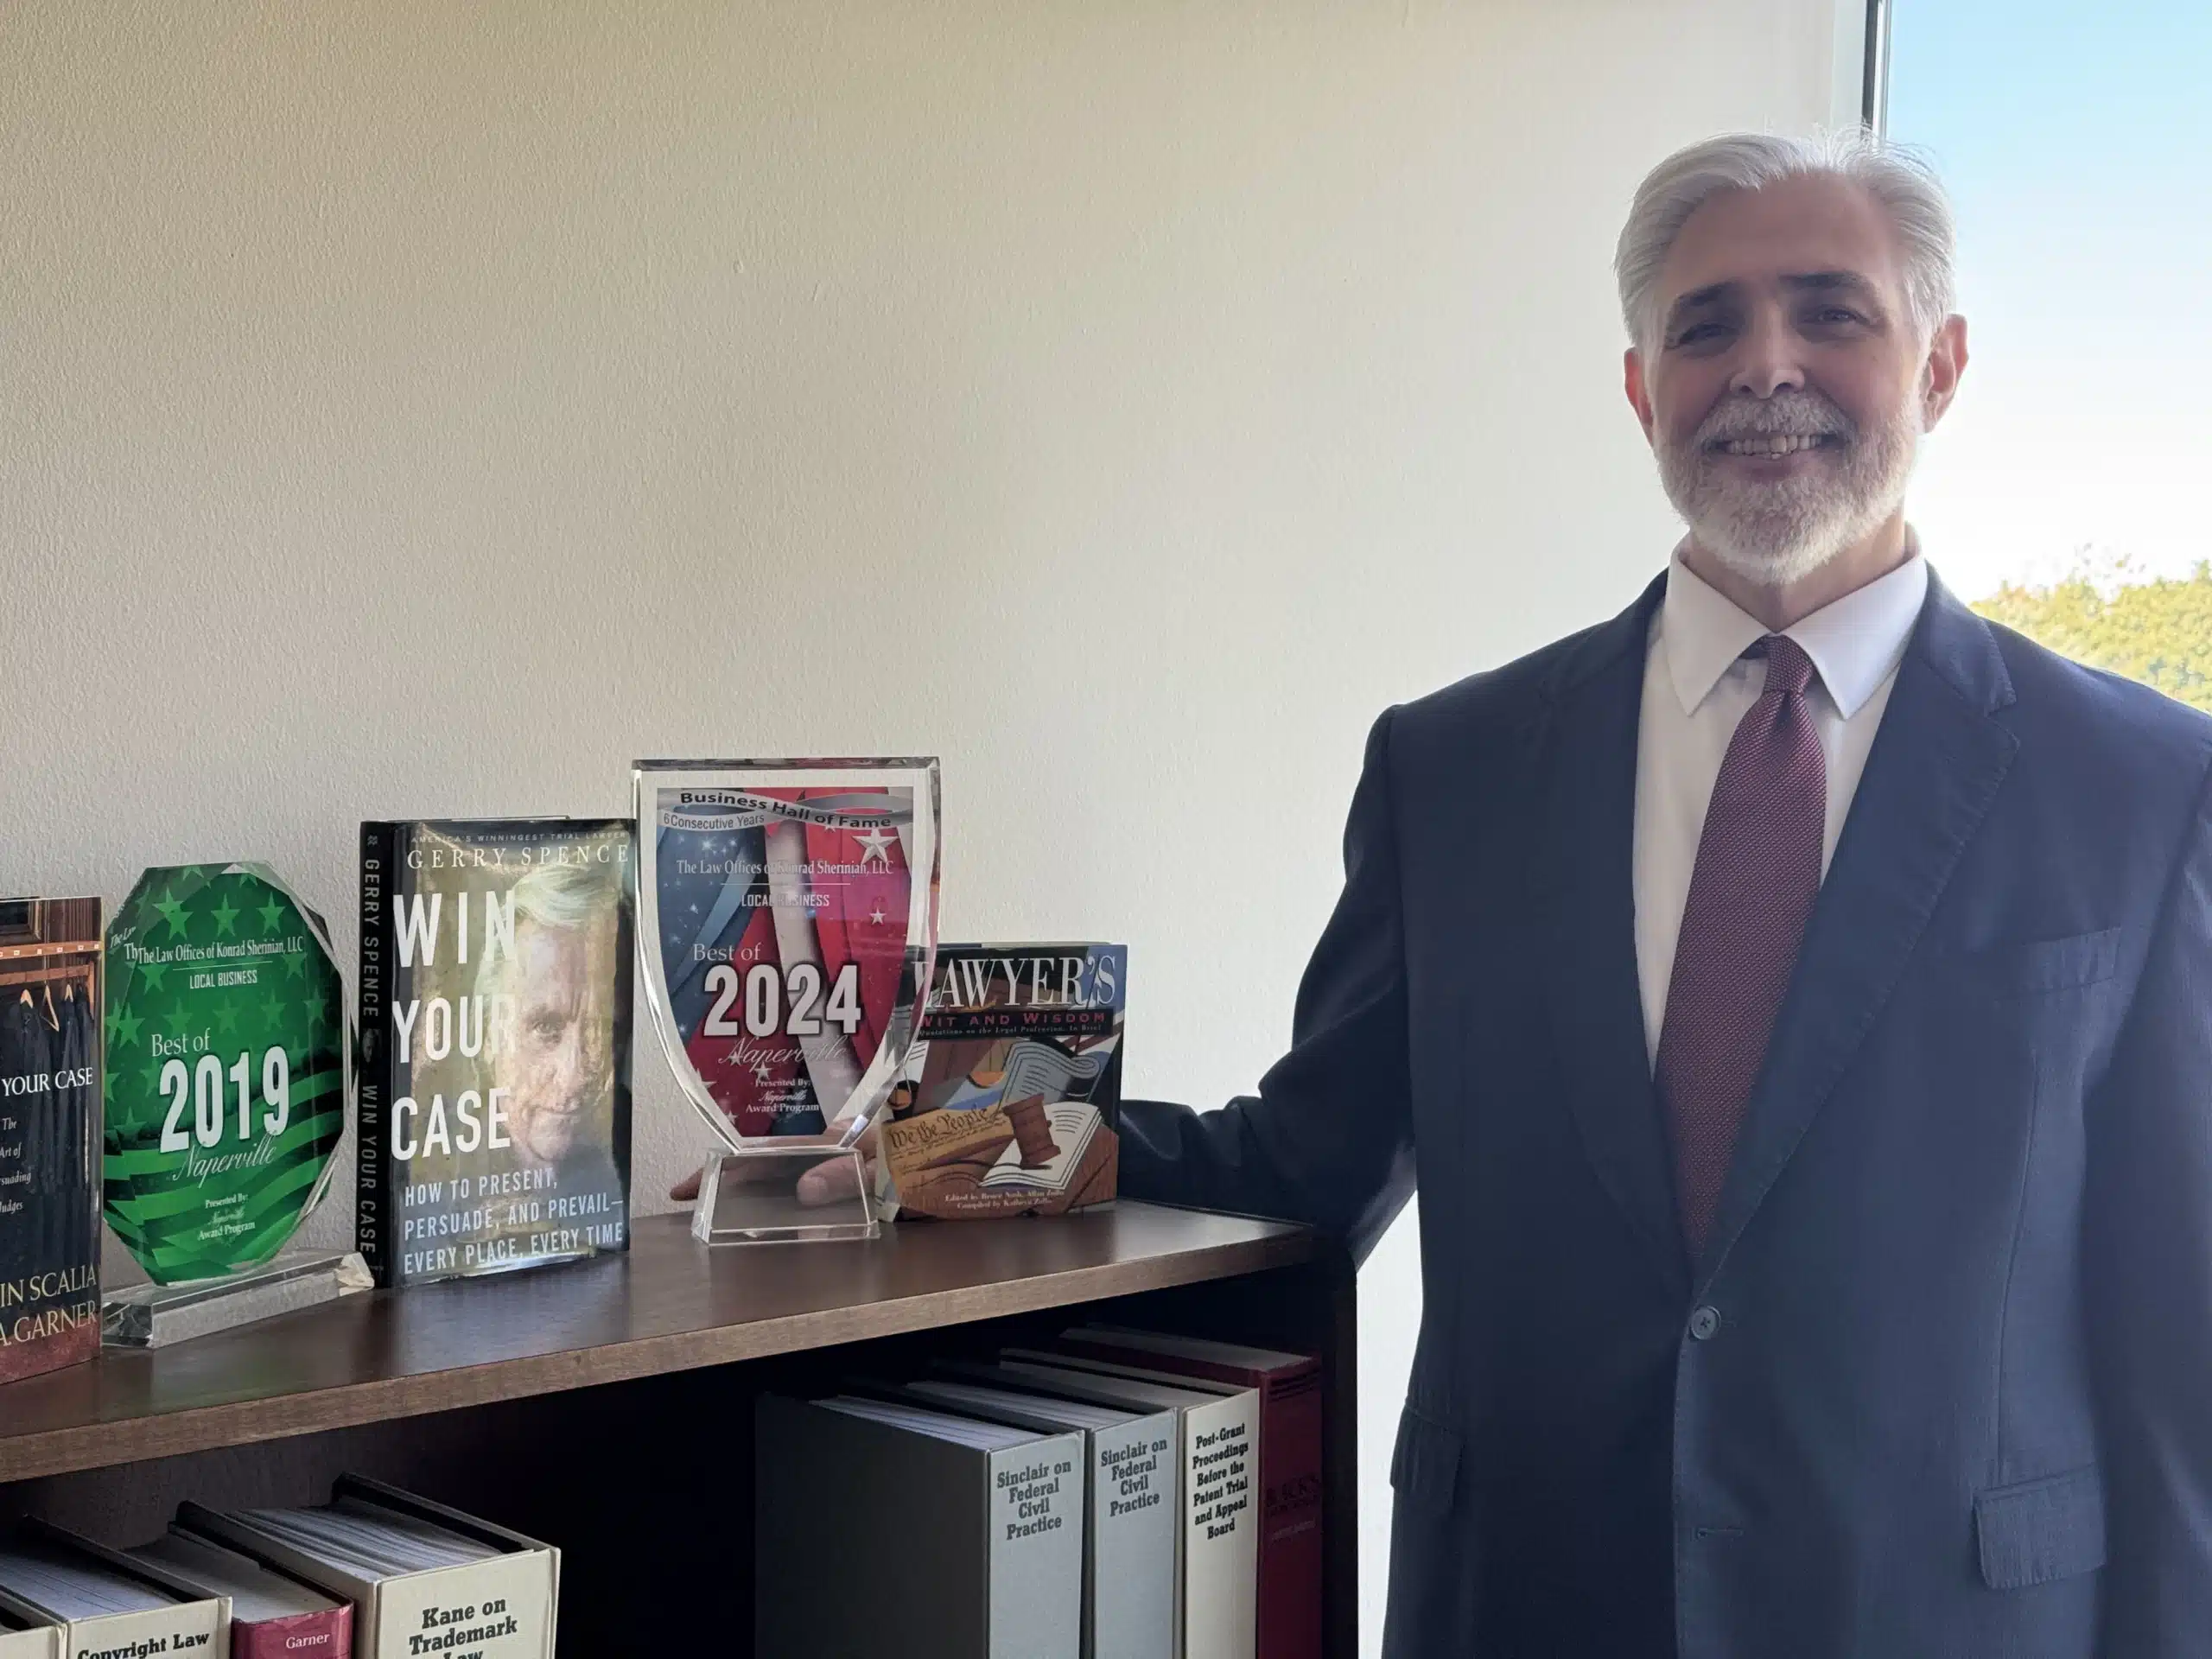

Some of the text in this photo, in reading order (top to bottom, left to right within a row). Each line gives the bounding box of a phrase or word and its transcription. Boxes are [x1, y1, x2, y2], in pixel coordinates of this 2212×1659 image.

[671, 815, 734, 830] Consecutive
[736, 813, 765, 827] Years
[681, 792, 892, 828] Business Hall of Fame
[477, 834, 544, 842] WINNINGEST
[407, 843, 629, 869] GERRY SPENCE
[676, 860, 698, 874] The
[699, 860, 723, 874] Law
[724, 858, 761, 875] Offices
[872, 860, 894, 874] LLC
[741, 893, 774, 907] LOCAL
[363, 858, 380, 1017] GERRY SPENCE
[393, 890, 516, 968] WIN
[137, 936, 303, 964] The Law Offices of Konrad Sherinian, LLC
[693, 942, 763, 962] Best of
[189, 969, 257, 989] LOCAL BUSINESS
[703, 963, 861, 1037] 2024
[391, 995, 517, 1064] YOUR
[969, 1014, 1010, 1027] AND
[1023, 1012, 1106, 1025] WISDOM
[151, 1027, 211, 1057] Best of
[718, 1035, 849, 1073] Naperville
[3, 1067, 93, 1096] YOUR CASE
[755, 1077, 795, 1088] Presented
[159, 1046, 289, 1154] 2019
[746, 1103, 819, 1114] Award Program
[2, 1116, 17, 1131] The
[391, 1086, 511, 1160] CASE
[888, 1127, 917, 1148] We
[917, 1121, 938, 1143] the
[937, 1103, 988, 1134] People
[13, 1141, 22, 1159] of
[172, 1131, 277, 1189] Naperville
[0, 1169, 32, 1186] suading
[359, 1084, 378, 1254] WIN YOUR CASE
[404, 1166, 558, 1207] HOW TO PRESENT,
[197, 1222, 256, 1242] Award Program
[404, 1209, 500, 1241] PERSUADE,
[508, 1200, 540, 1225] AND
[404, 1222, 624, 1275] EVERY PLACE, EVERY TIME
[29, 1262, 97, 1301] SCALIA
[14, 1300, 97, 1342] GARNER
[1195, 1422, 1245, 1450] Post-Grant
[1101, 1439, 1167, 1466] Sinclair on
[1192, 1442, 1249, 1470] Proceedings
[996, 1460, 1071, 1489] Sinclair on
[1111, 1454, 1157, 1482] Federal
[1197, 1461, 1244, 1487] Before the
[1009, 1477, 1059, 1503] Federal
[1120, 1474, 1149, 1497] Civil
[1193, 1485, 1223, 1507] Patent
[1226, 1476, 1248, 1496] Trial
[1018, 1496, 1051, 1519] Civil
[1109, 1491, 1160, 1516] Practice
[1194, 1508, 1212, 1525] and
[1215, 1494, 1248, 1519] Appeal
[1006, 1516, 1062, 1541] Practice
[1207, 1517, 1236, 1540] Board
[422, 1599, 506, 1629] Kane on
[77, 1633, 210, 1659] Copyright Law
[286, 1632, 330, 1649] Garner
[409, 1615, 518, 1656] Trademark
